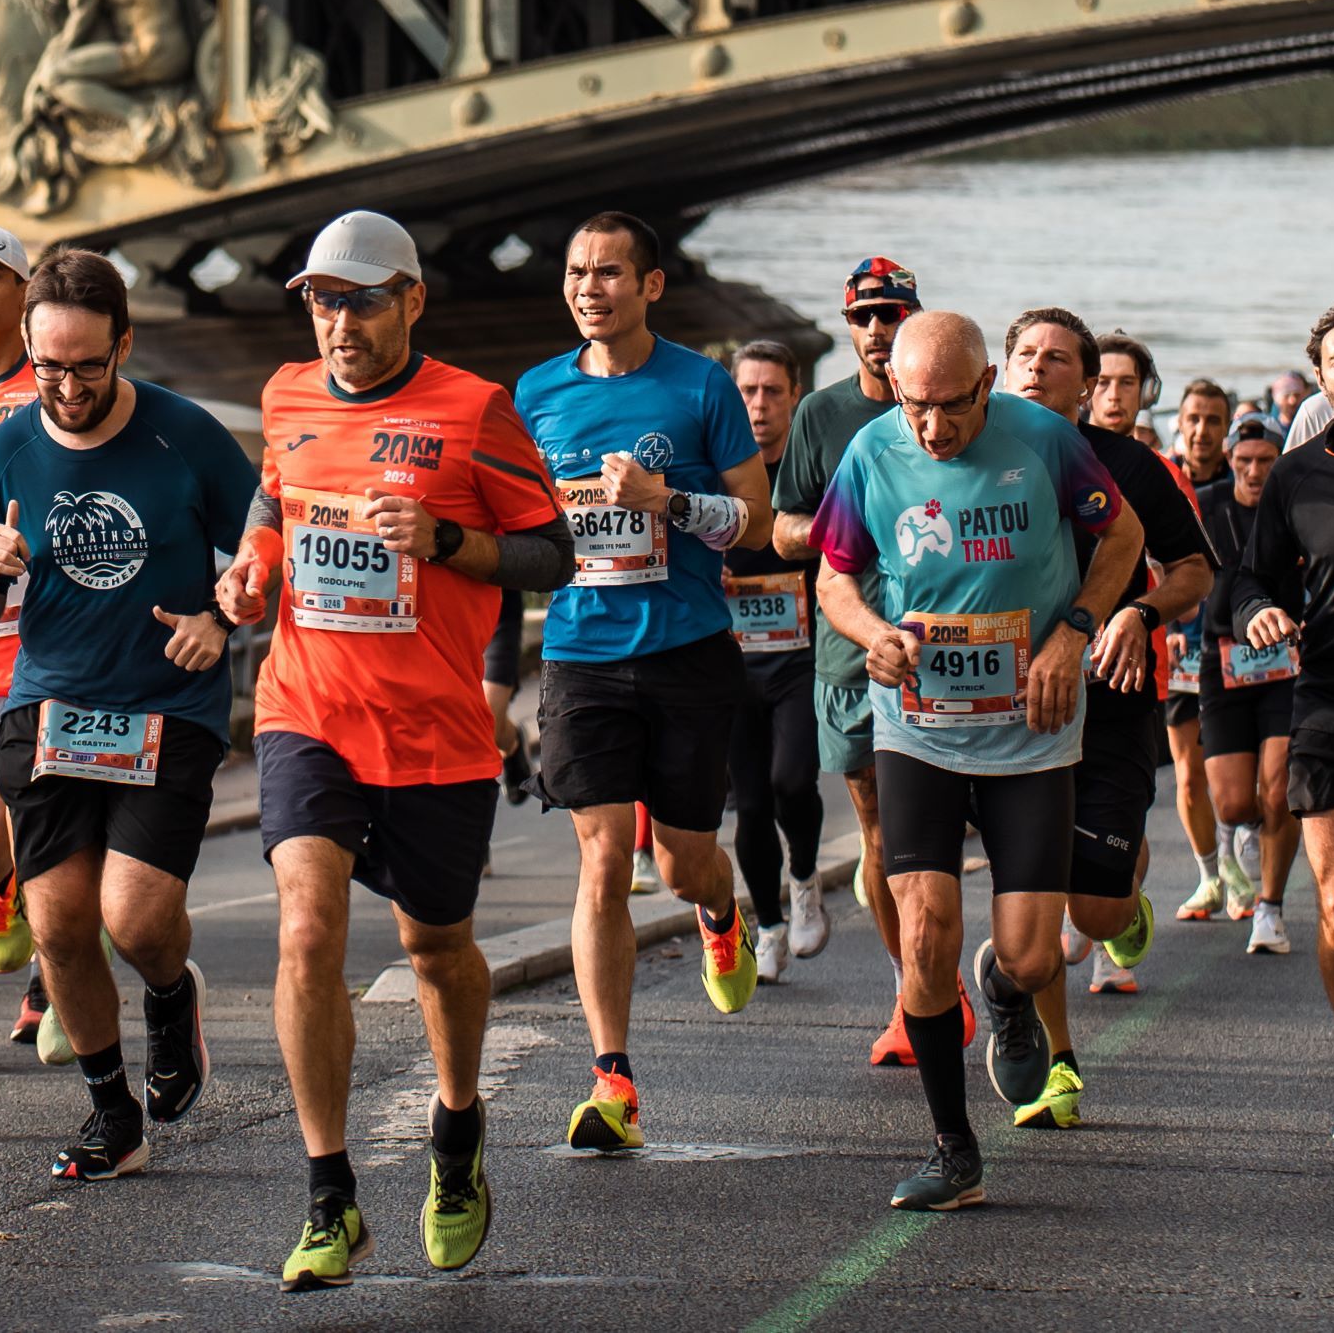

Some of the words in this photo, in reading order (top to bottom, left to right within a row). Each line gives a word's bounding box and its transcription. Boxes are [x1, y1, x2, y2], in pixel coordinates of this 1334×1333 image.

[369, 432, 409, 464] 20
[410, 435, 444, 459] KM
[408, 456, 440, 471] PARIS
[383, 470, 415, 485] 2024
[577, 489, 594, 505] 20
[310, 504, 331, 526] 20
[332, 507, 348, 521] KM
[572, 511, 645, 537] 36478
[958, 502, 1029, 537] PATOU
[52, 528, 147, 548] MARATHON
[54, 548, 69, 557] DES
[73, 542, 149, 554] ALPES-MARITIMES
[55, 552, 113, 565] NICE-CANNES
[300, 533, 390, 574] 19055
[962, 537, 1015, 562] TRAIL
[318, 577, 366, 589] RODOLPHE
[401, 573, 413, 583] 24
[739, 597, 786, 617] 5338
[973, 616, 1010, 629] DANCE
[930, 625, 951, 644] 20
[952, 625, 969, 637] KM
[930, 649, 1000, 677] 4916
[950, 684, 985, 692] PATRICK
[60, 711, 131, 737] 2243
[1107, 834, 1130, 851] GORE
